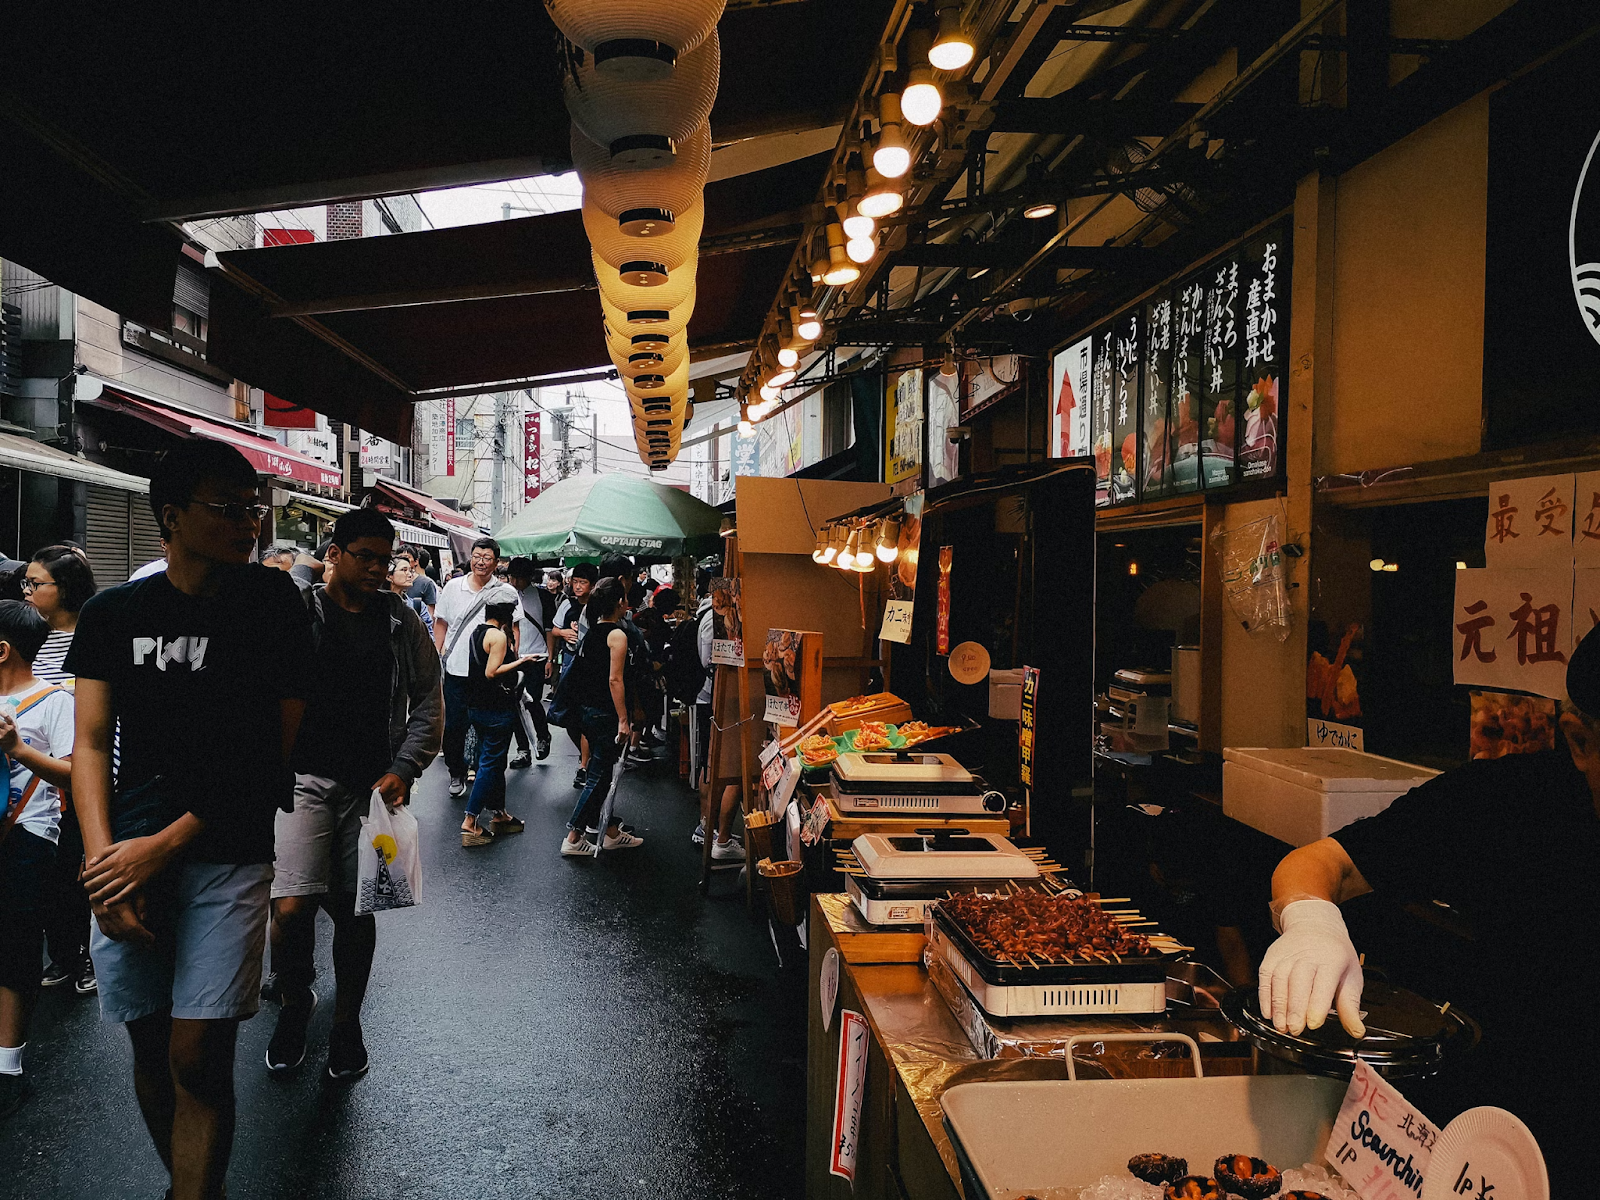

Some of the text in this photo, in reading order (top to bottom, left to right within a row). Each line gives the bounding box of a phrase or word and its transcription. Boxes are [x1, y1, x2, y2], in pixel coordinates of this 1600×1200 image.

[1128, 316, 1139, 366] うに
[1177, 285, 1193, 404] ざんまい丼
[1191, 282, 1205, 338] かに
[1210, 266, 1227, 395] ざんまい丼
[1224, 261, 1240, 350] まぐろ
[1244, 278, 1262, 369] 産直丼
[1260, 242, 1278, 364] おまかせ
[1147, 303, 1163, 416] ざんまい丼
[600, 536, 663, 549] CAPTAIN STAG
[1316, 722, 1358, 749] ゆでかに
[1355, 1067, 1389, 1121] うに
